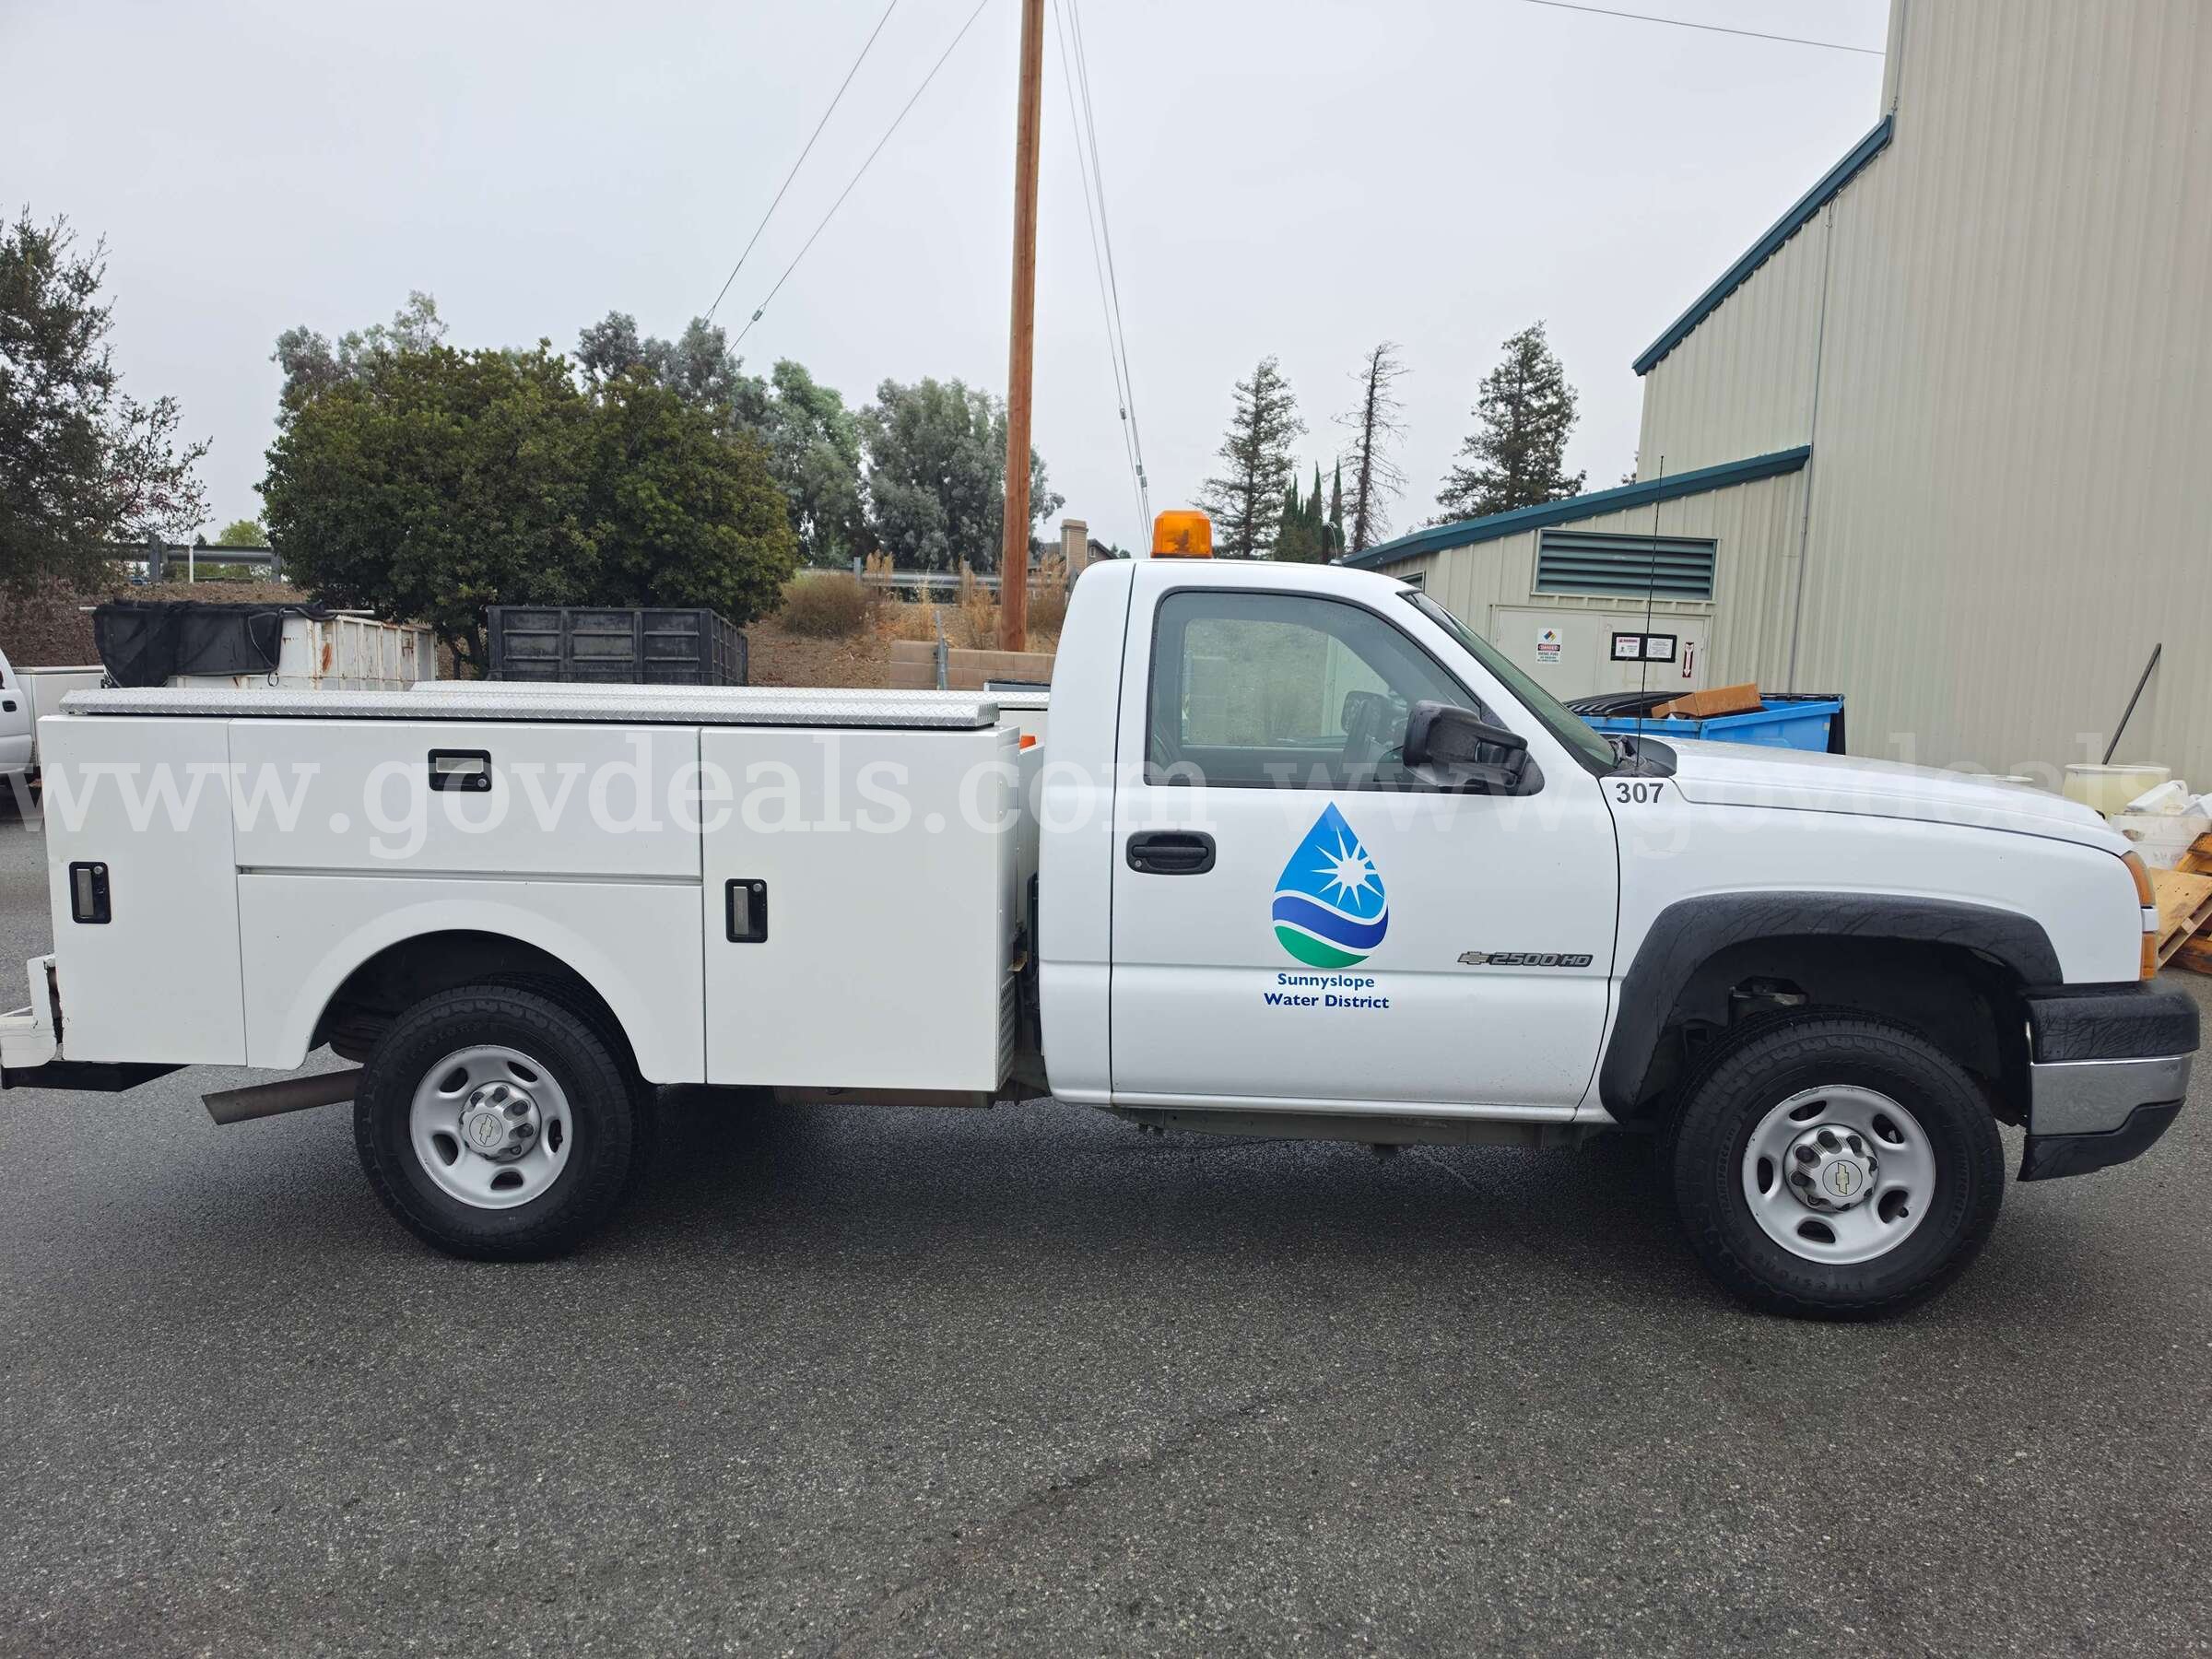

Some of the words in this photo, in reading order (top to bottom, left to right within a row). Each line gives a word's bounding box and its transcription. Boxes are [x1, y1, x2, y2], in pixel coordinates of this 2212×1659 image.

[1616, 782, 1664, 804] 307
[1490, 952, 1559, 966] 2500
[1559, 954, 1593, 967] HD
[1277, 973, 1375, 991] Sunnyslope
[1264, 993, 1320, 1007] Water
[1324, 994, 1390, 1009] District
